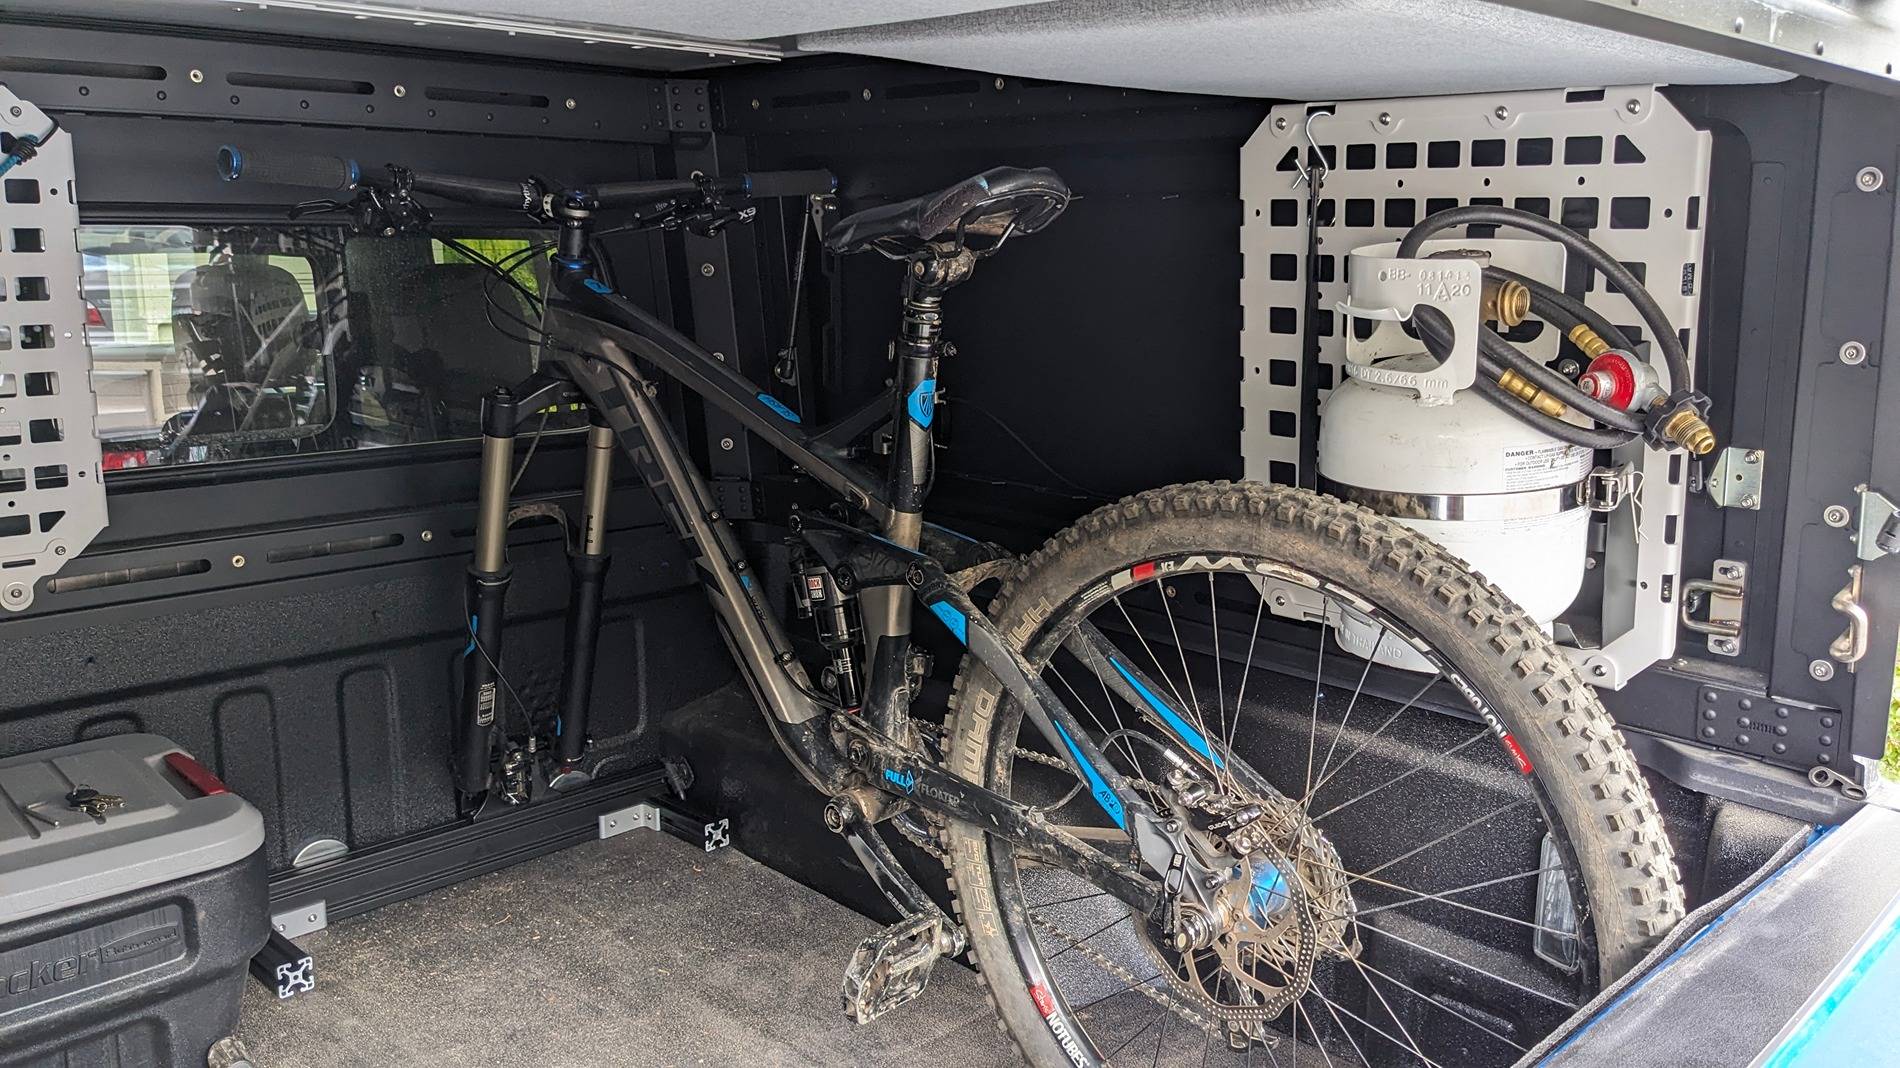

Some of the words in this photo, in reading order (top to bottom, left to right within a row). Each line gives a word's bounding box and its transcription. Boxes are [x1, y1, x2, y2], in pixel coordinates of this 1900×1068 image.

[738, 207, 757, 220] X9
[1422, 378, 1449, 390] mm
[1505, 450, 1534, 458] DANGER
[1352, 632, 1403, 660] THAIAND
[885, 768, 907, 787] FULL
[920, 783, 961, 808] FLOATER
